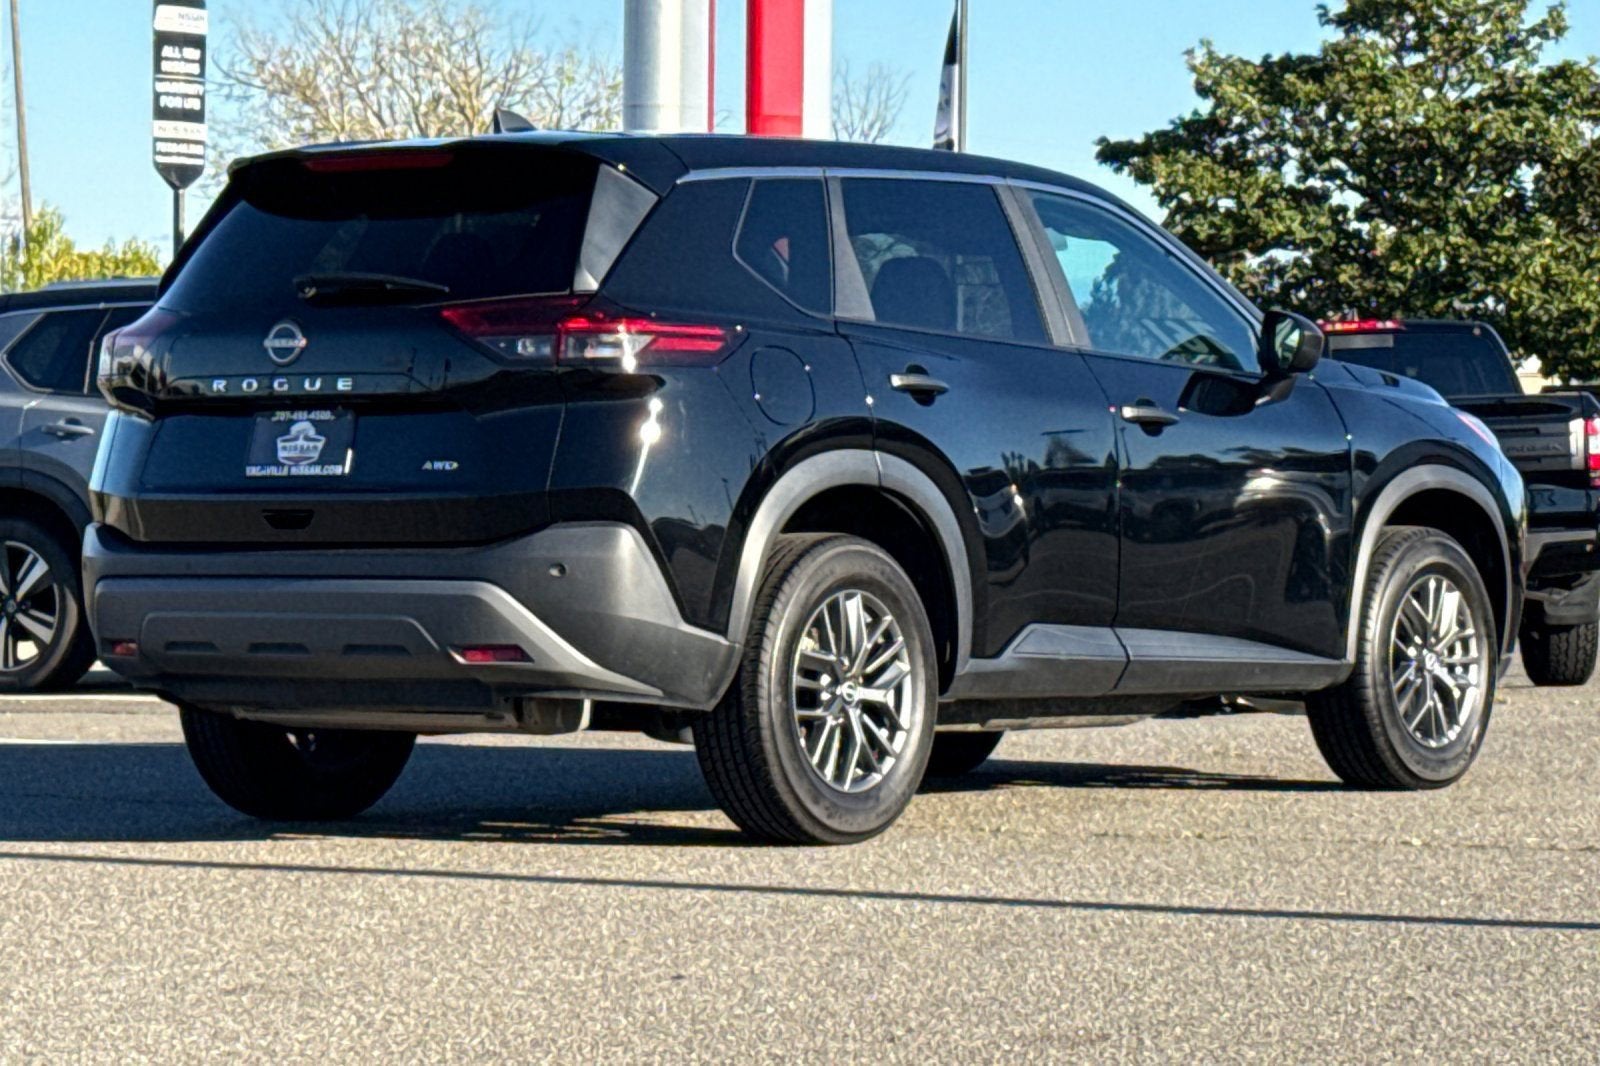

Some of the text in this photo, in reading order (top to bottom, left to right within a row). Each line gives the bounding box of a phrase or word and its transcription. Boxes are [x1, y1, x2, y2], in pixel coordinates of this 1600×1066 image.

[162, 45, 181, 59] ALL
[159, 95, 183, 109] FOR
[212, 377, 353, 393] ROGUE
[421, 460, 459, 471] AWD
